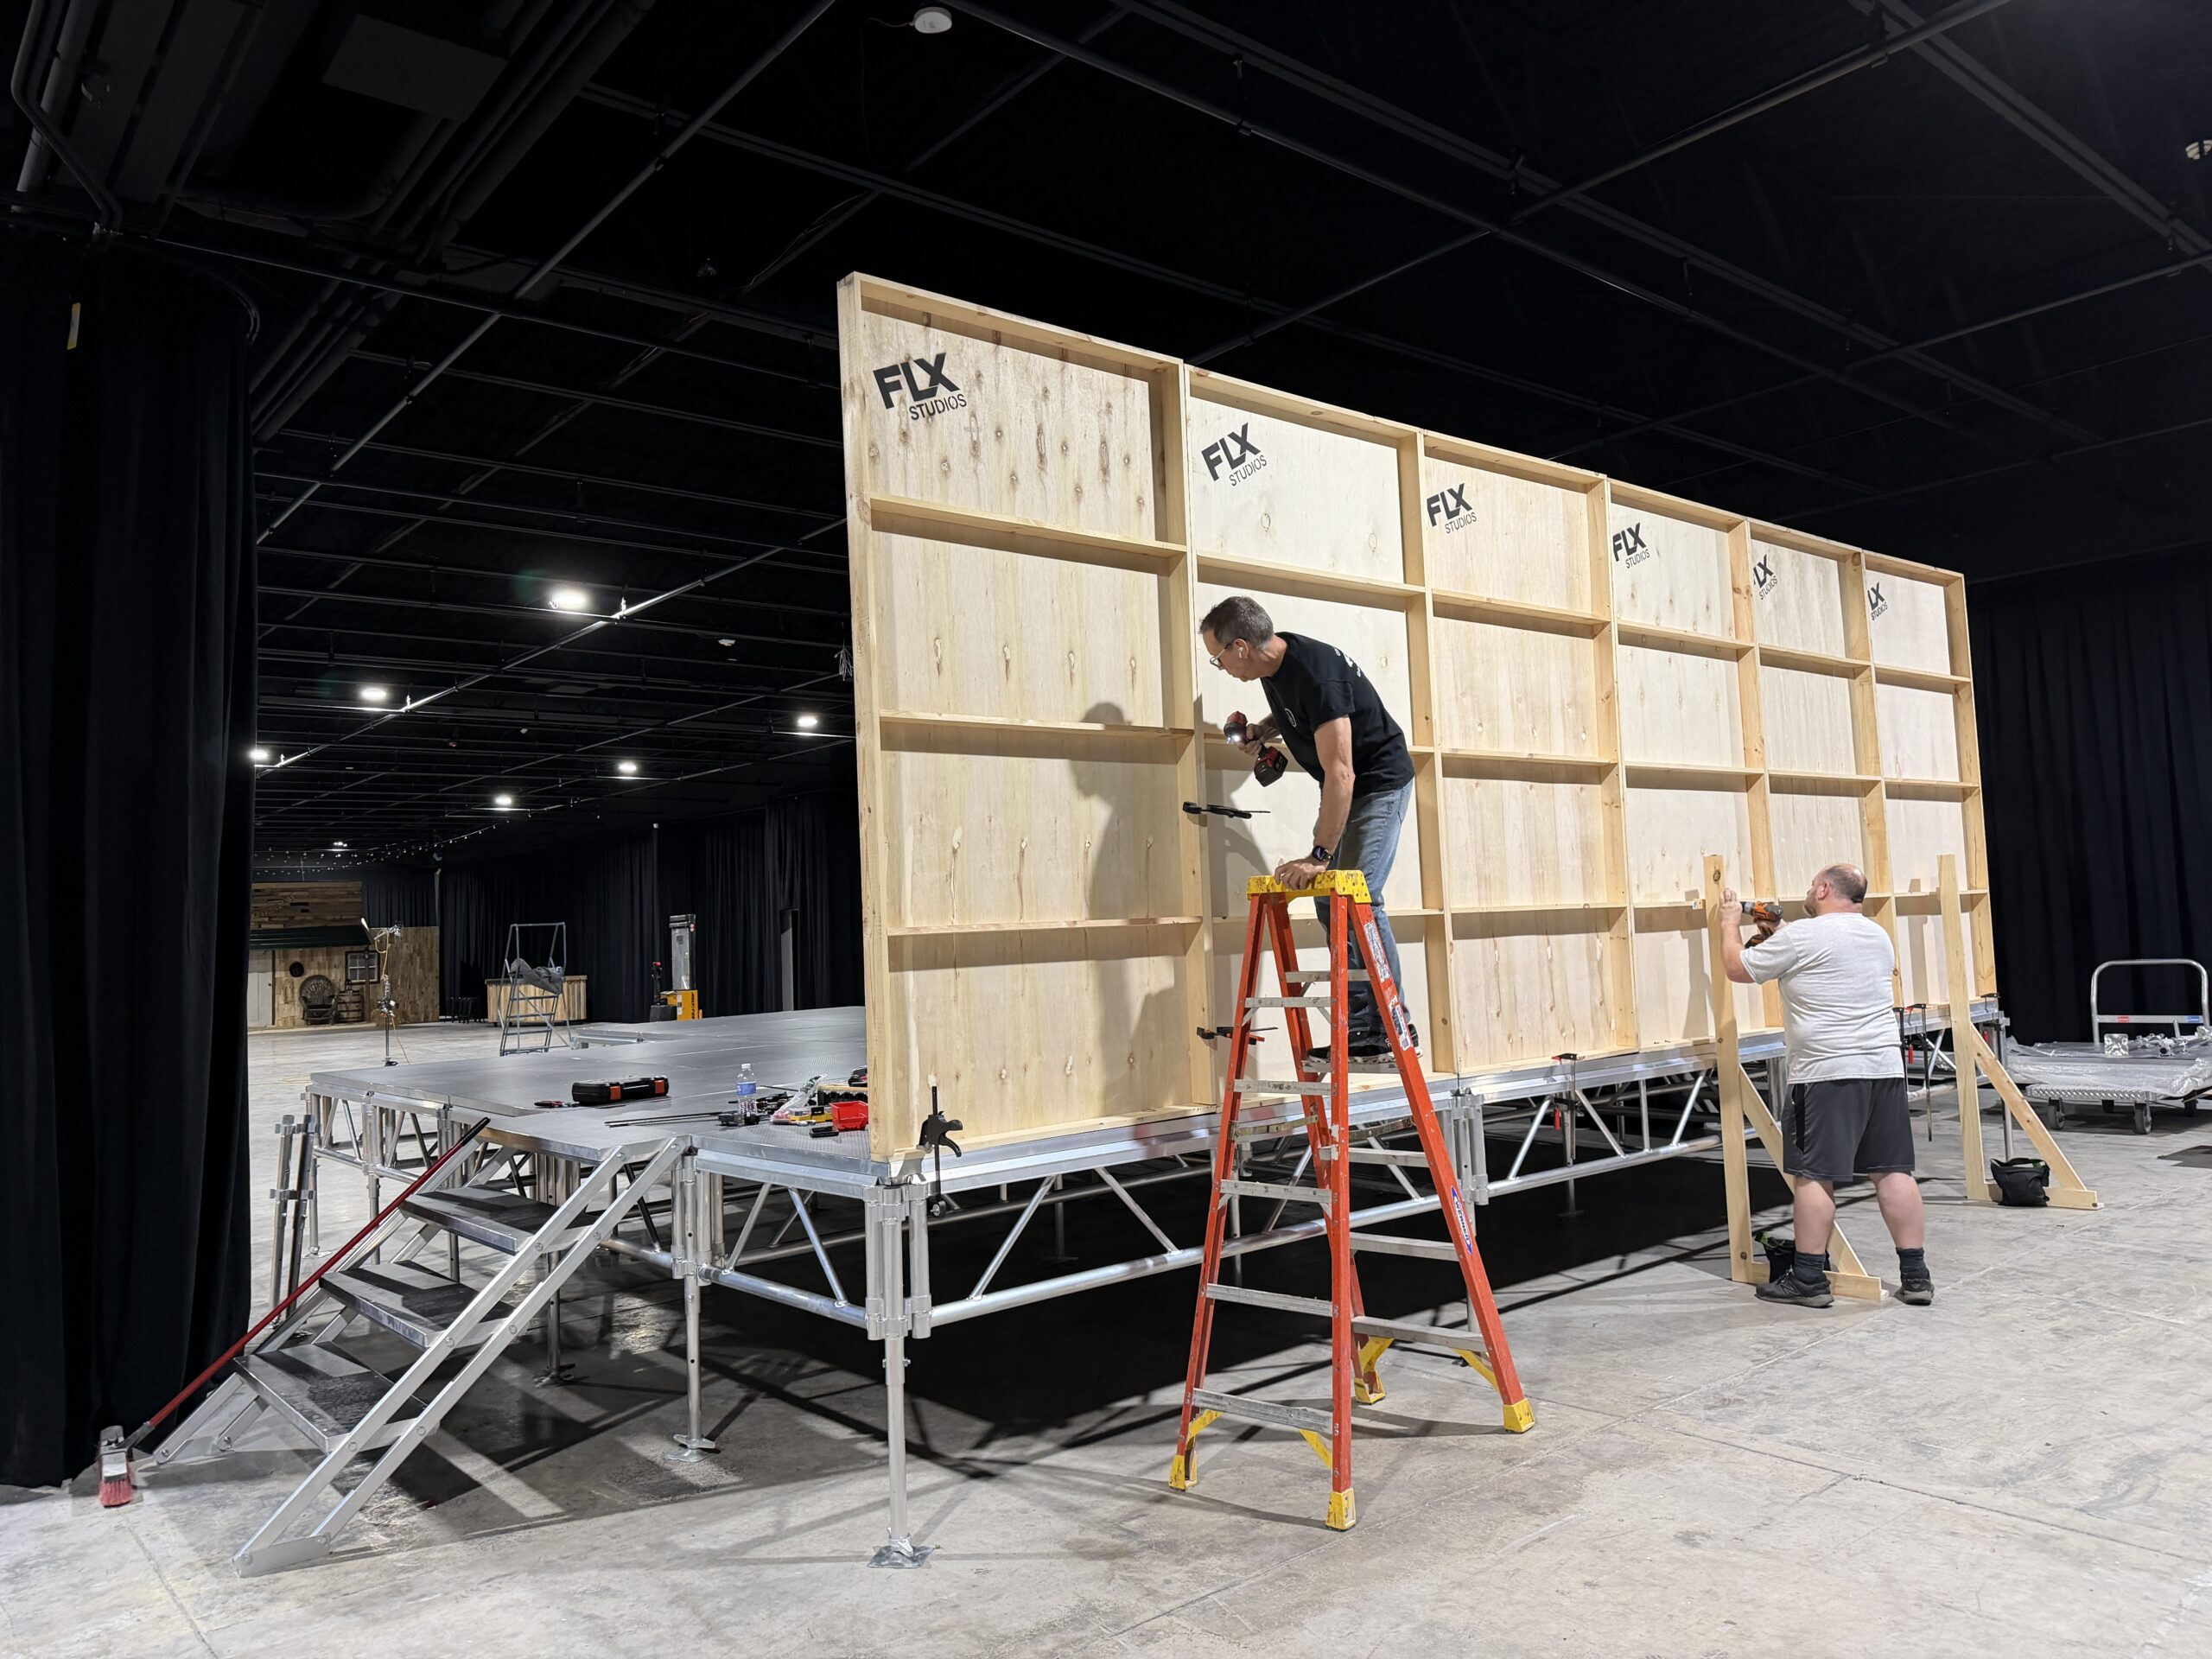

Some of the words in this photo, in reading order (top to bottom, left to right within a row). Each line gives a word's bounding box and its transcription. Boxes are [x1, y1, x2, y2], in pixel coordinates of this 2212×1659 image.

[873, 352, 961, 410] FLX
[909, 393, 967, 420] STUDIOS
[1201, 422, 1262, 481] FLX
[1229, 454, 1268, 486] STUDIOS
[1427, 482, 1473, 527] FLX
[1445, 512, 1477, 534] STUDIOS
[1612, 522, 1647, 563] FLX
[1625, 549, 1650, 569] STUDIOS
[1753, 553, 1774, 588] LX
[1758, 575, 1777, 600] STUDIOS
[1867, 582, 1885, 611] LX
[1456, 1200, 1470, 1241] WERNER
